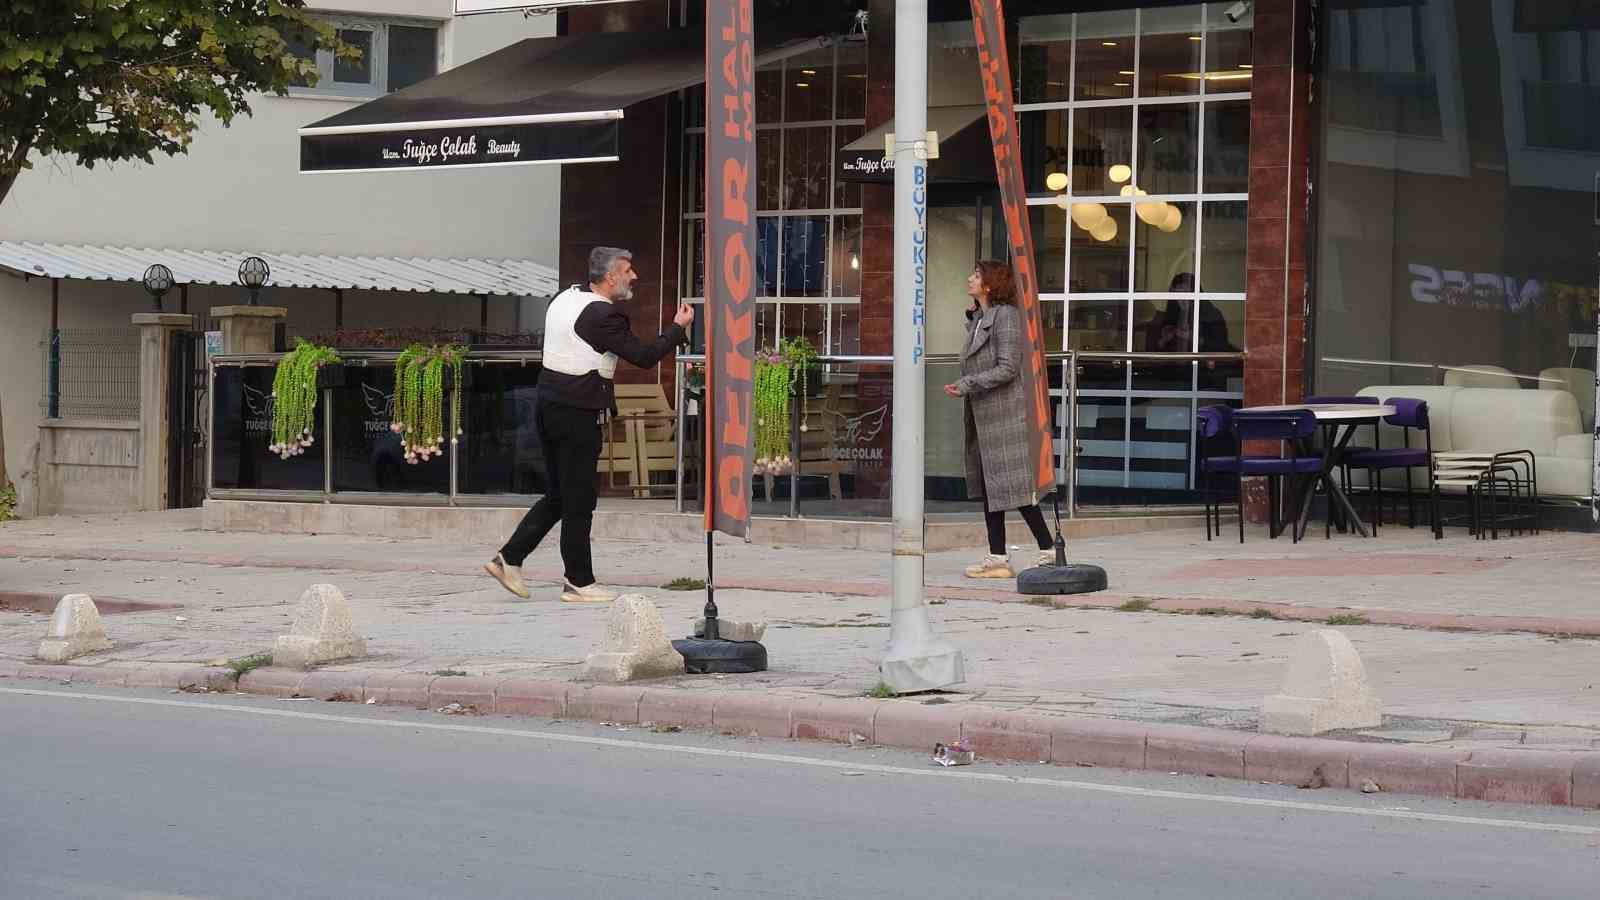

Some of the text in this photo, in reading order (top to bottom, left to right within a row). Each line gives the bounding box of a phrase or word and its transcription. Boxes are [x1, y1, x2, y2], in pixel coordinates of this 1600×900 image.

[402, 138, 438, 164] Tuğçe
[440, 135, 478, 161] Çolak
[487, 139, 521, 158] Beauty
[718, 157, 752, 521] DEKOR
